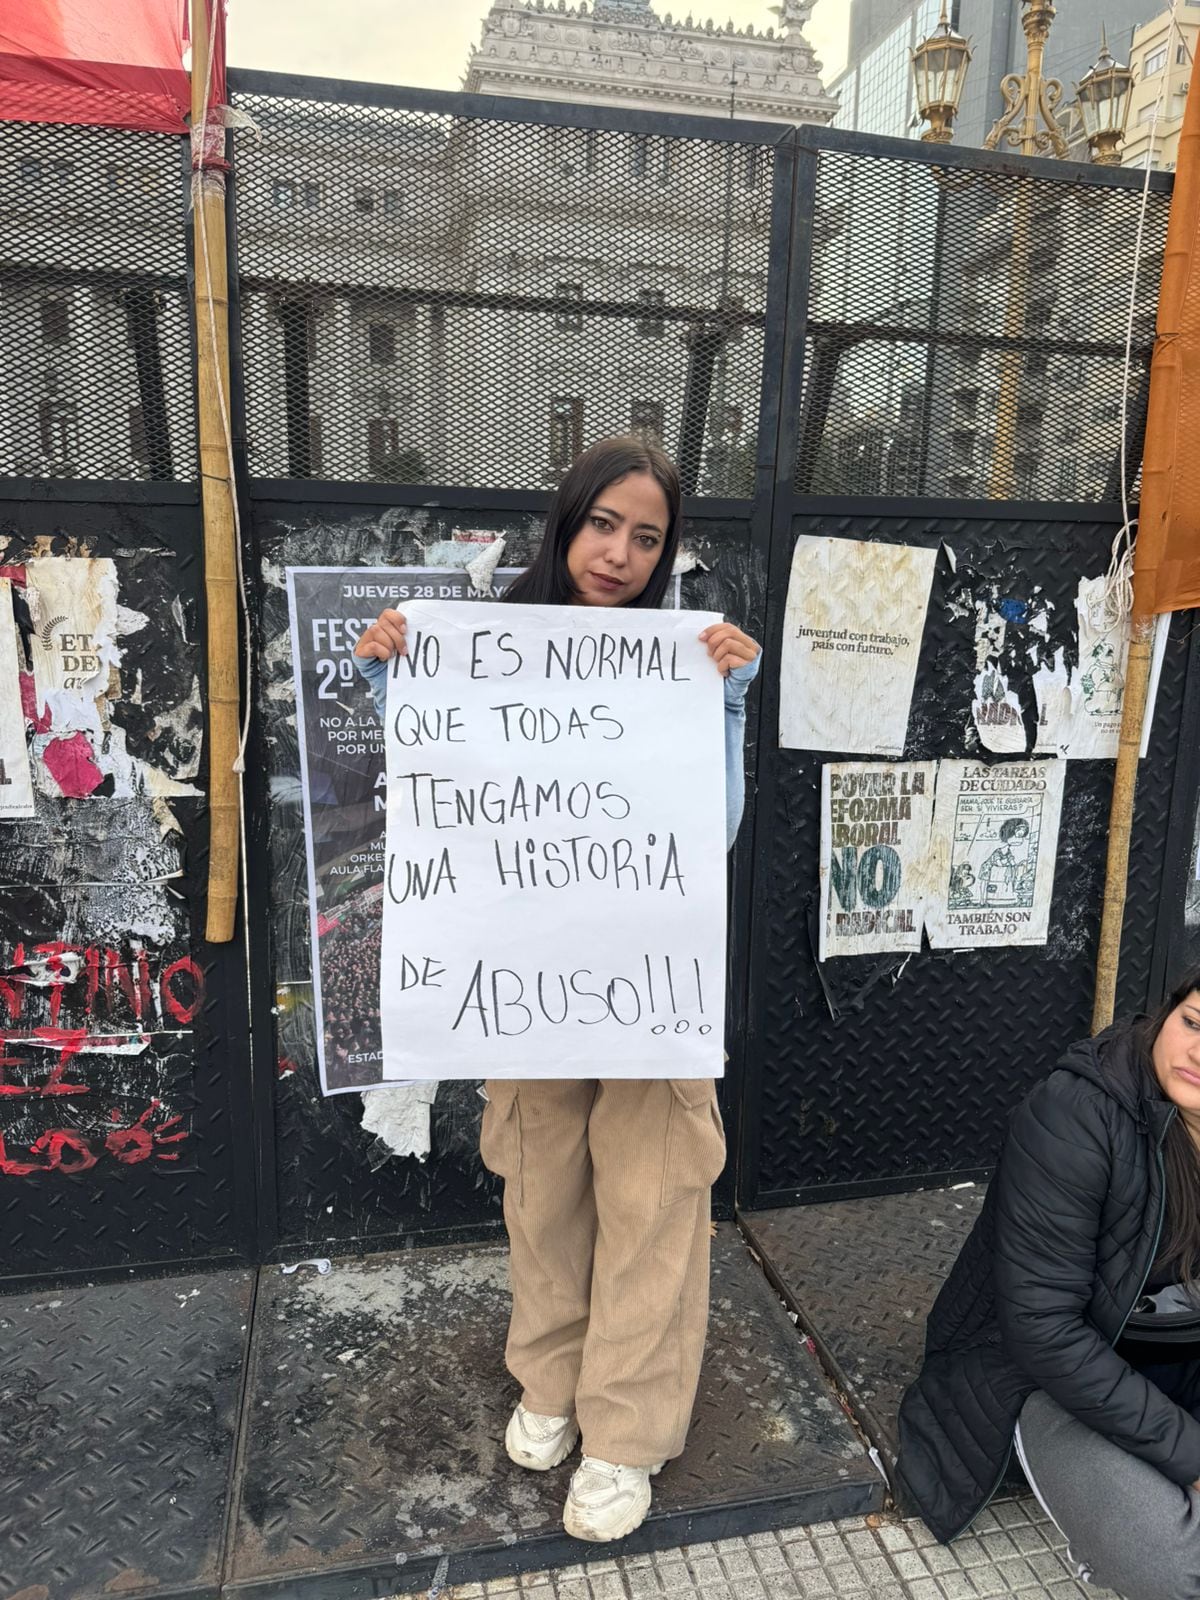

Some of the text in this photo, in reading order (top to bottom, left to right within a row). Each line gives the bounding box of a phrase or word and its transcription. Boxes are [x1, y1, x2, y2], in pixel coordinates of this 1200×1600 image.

[343, 585, 410, 599] JUEVES
[414, 585, 435, 598] 28
[439, 585, 463, 598] DE
[312, 617, 378, 652] FES
[796, 625, 910, 648] juventud con trabajo,
[393, 630, 692, 682] NO ES NORMAL
[811, 638, 894, 656] país con futuro.
[320, 717, 341, 728] NO
[344, 716, 355, 727] A
[359, 716, 376, 727] LA
[394, 703, 624, 746] QUE TODAS
[328, 730, 386, 741] POR ME
[337, 744, 366, 755] POR
[963, 766, 1047, 778] LAS TAREAS
[900, 772, 925, 796] LA
[959, 780, 1047, 791] DE CUIDADO
[396, 773, 631, 829] TENGAMOS
[330, 865, 360, 875] AULA
[388, 848, 456, 904] UNA
[828, 845, 901, 912] NO
[836, 909, 916, 937] RADICAL
[946, 910, 1031, 924] TAMBIÉN SON
[959, 924, 1017, 935] TRABAJO
[401, 954, 446, 990] DE
